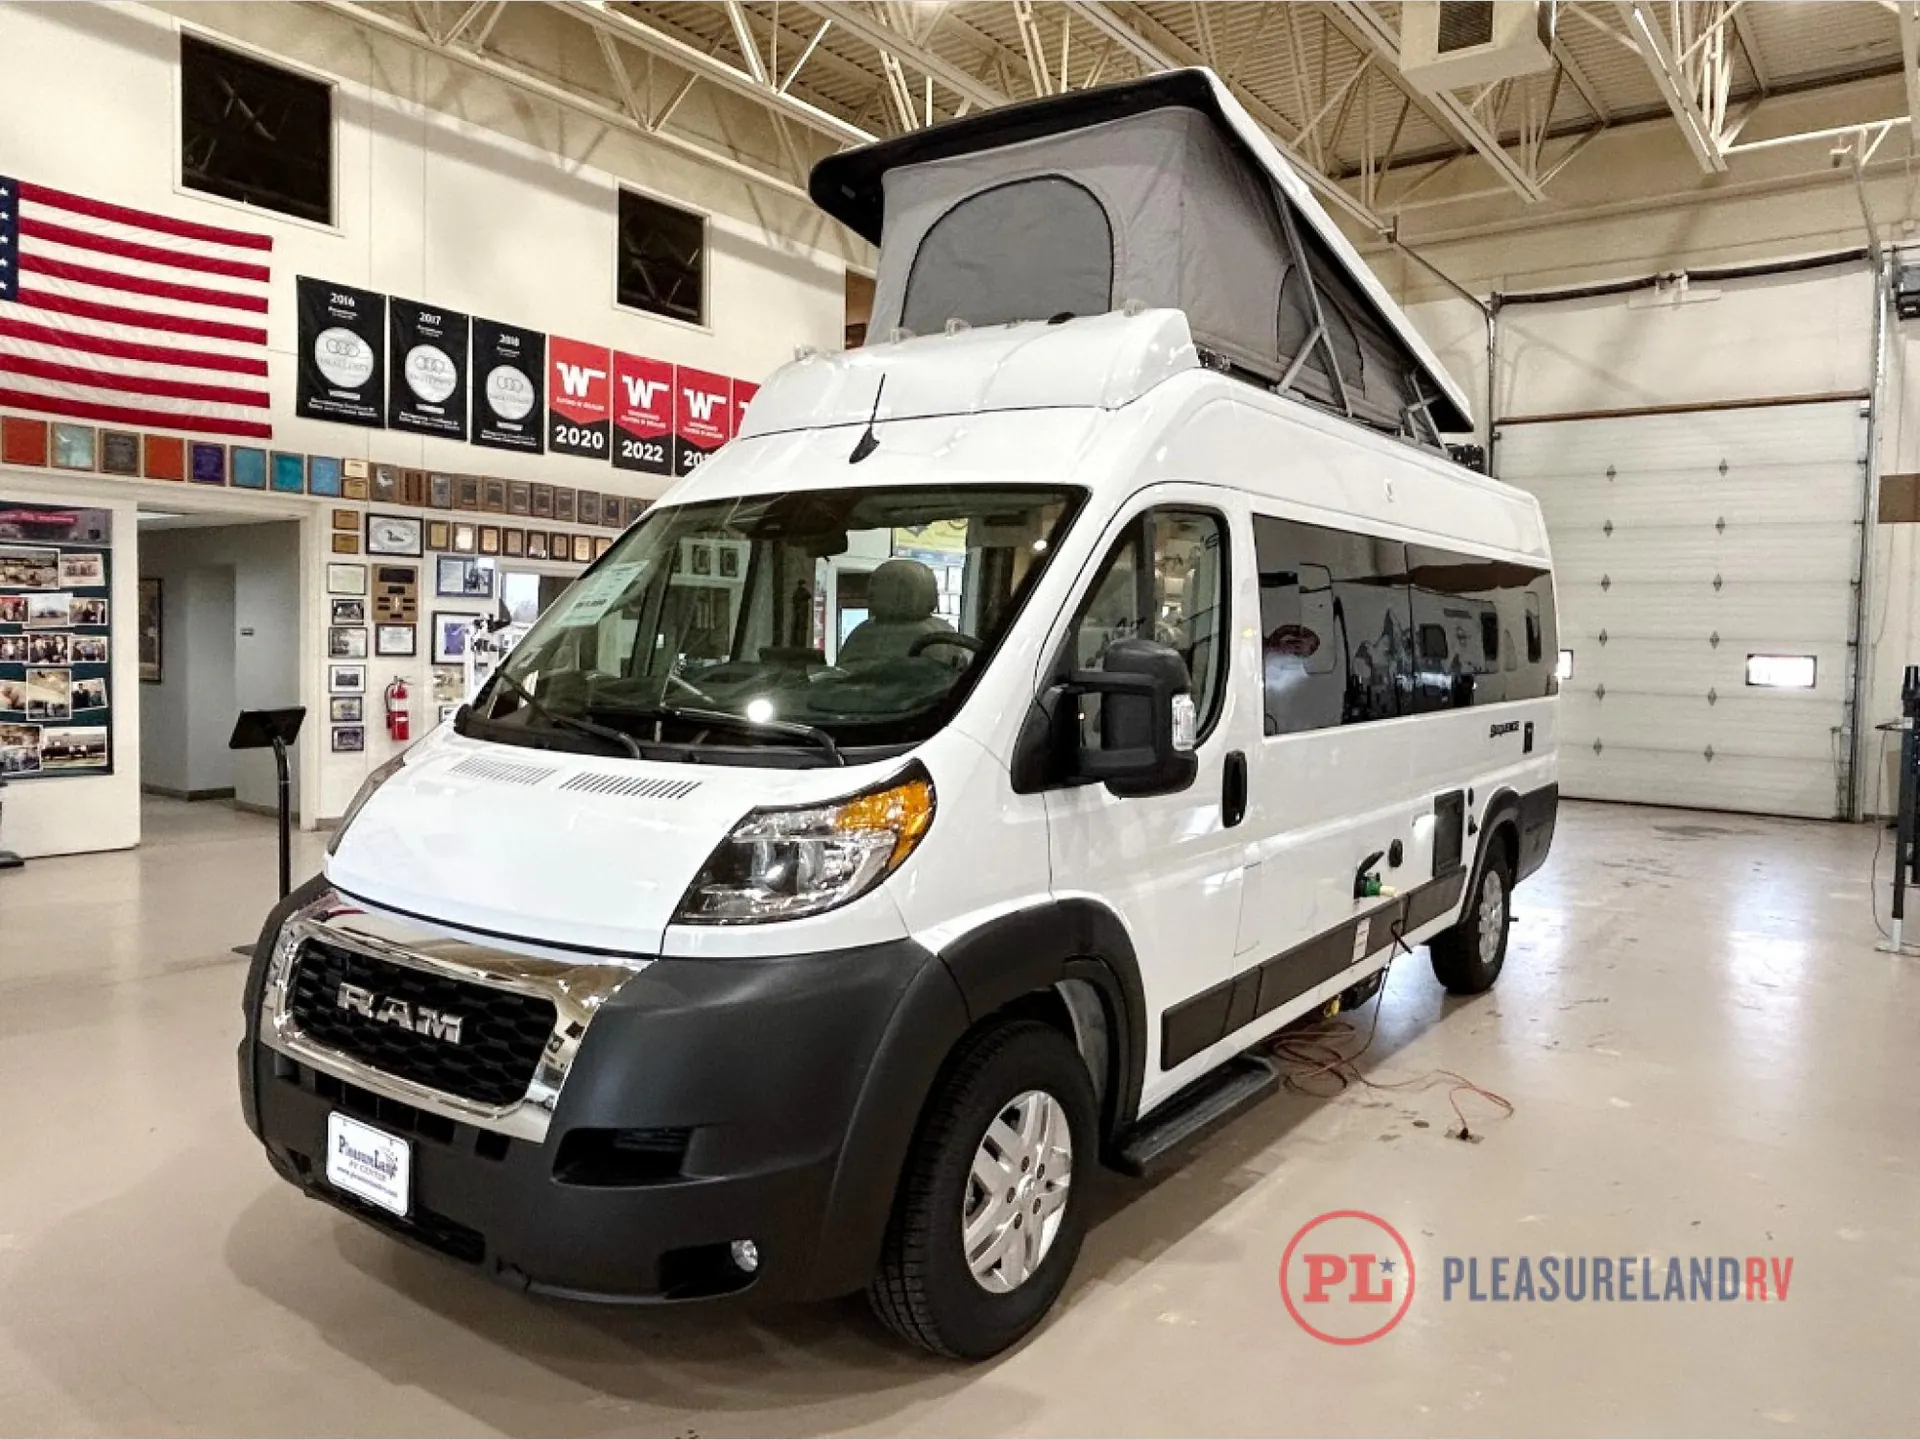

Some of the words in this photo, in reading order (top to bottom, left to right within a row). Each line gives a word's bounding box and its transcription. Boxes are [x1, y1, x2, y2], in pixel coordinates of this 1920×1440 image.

[330, 292, 355, 307] 2016
[419, 311, 442, 326] 2017
[555, 425, 604, 449] 2020
[621, 441, 664, 463] 2022
[337, 982, 462, 1044] RAM
